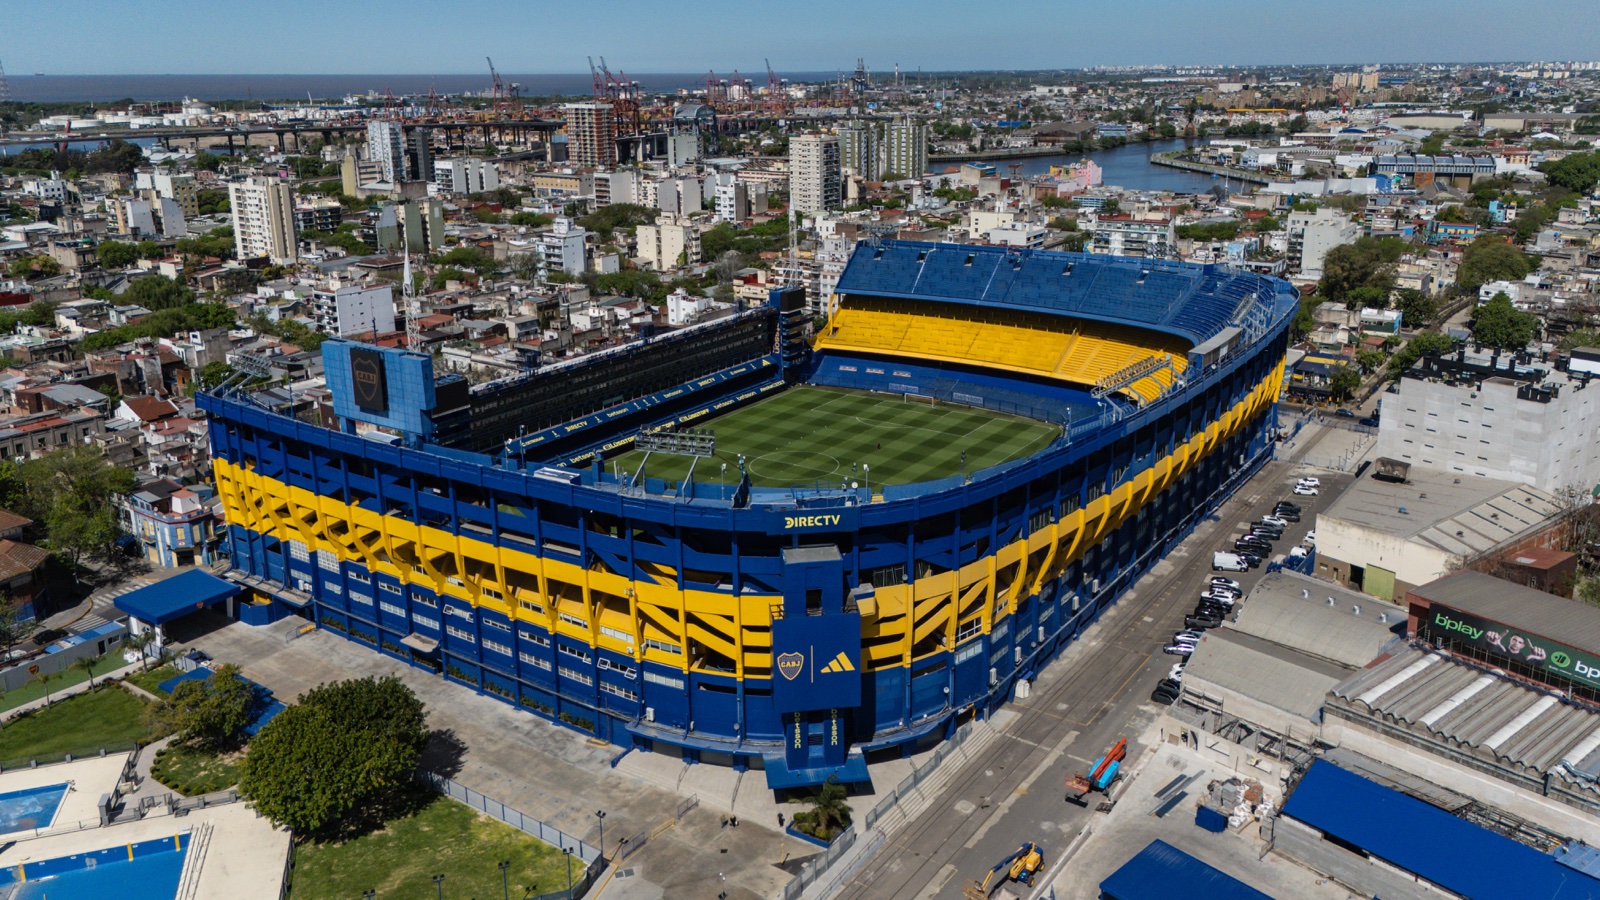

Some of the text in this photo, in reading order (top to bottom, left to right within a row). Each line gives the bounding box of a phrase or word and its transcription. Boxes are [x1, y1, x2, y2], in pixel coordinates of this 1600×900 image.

[564, 420, 588, 432] DIRECTV
[784, 514, 841, 529] DIRECTV
[1435, 613, 1484, 640] bplay
[781, 660, 801, 668] CABJ
